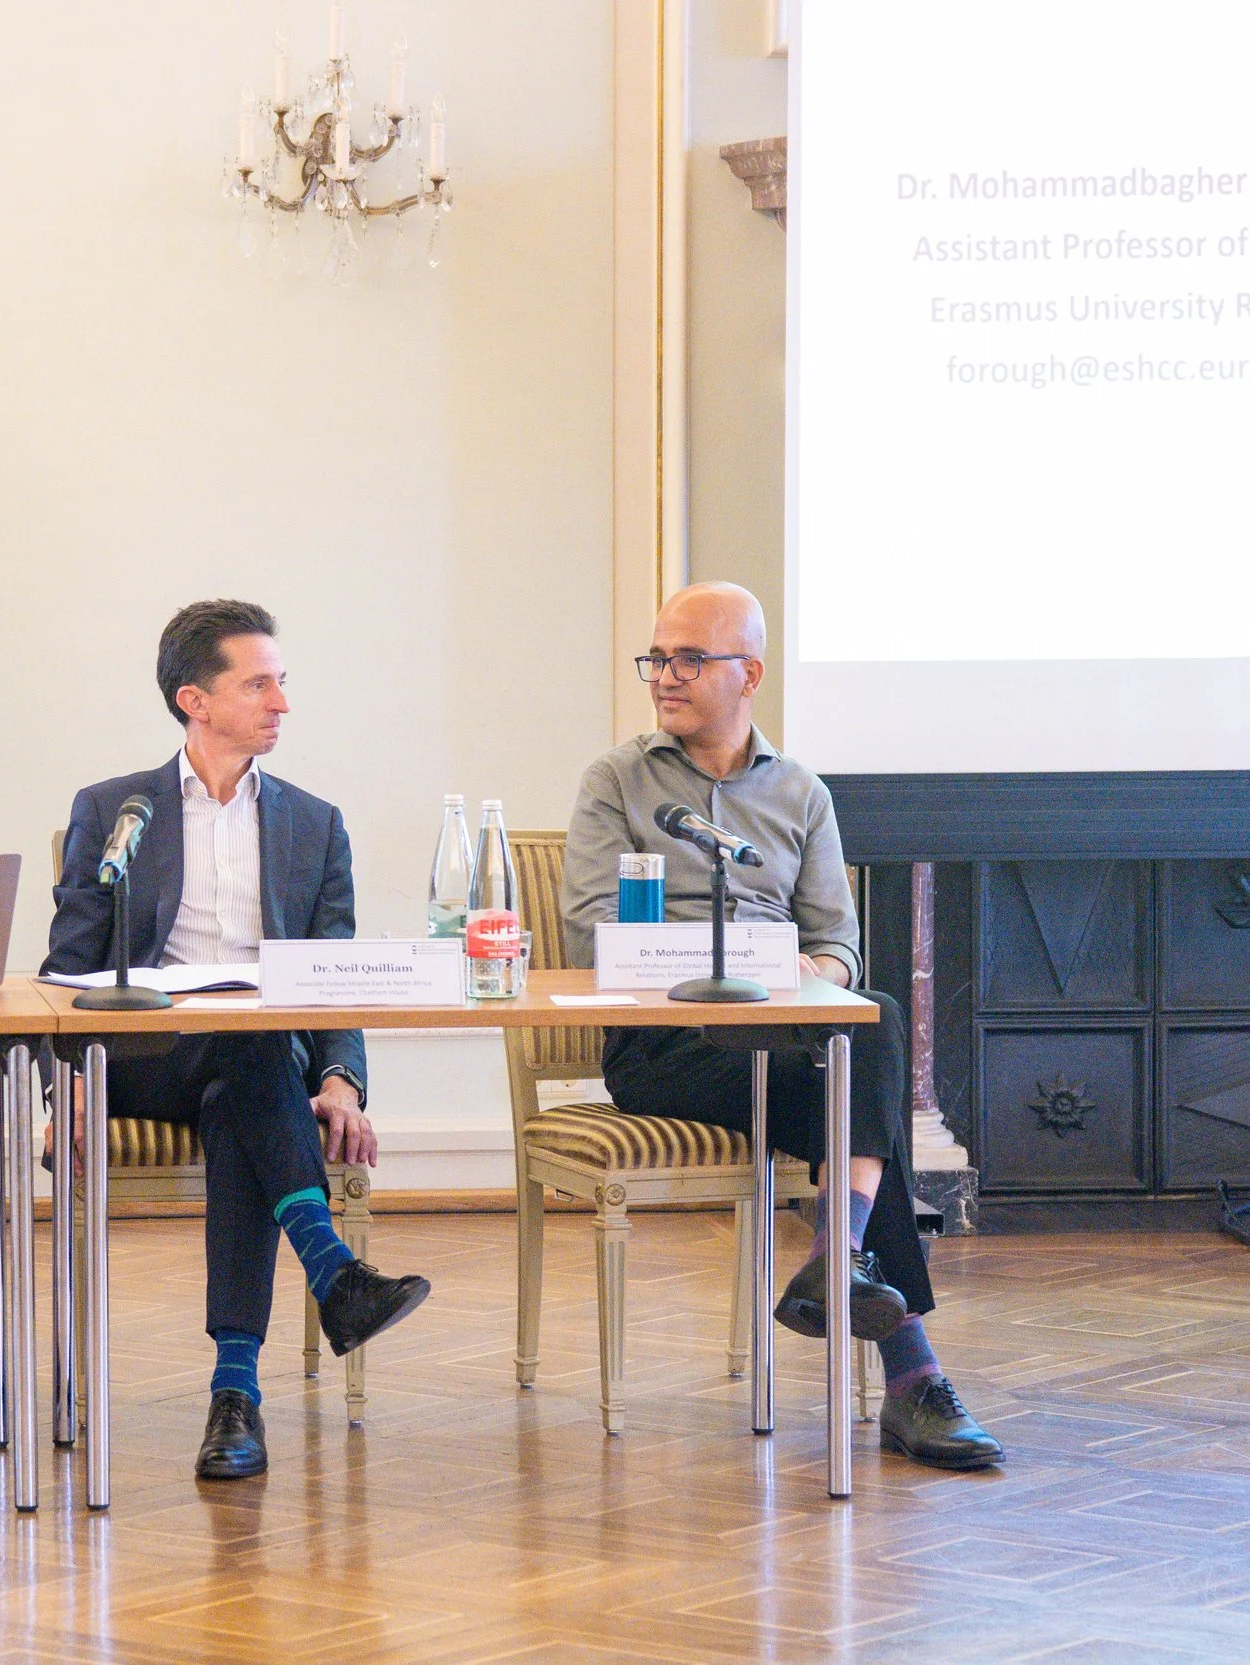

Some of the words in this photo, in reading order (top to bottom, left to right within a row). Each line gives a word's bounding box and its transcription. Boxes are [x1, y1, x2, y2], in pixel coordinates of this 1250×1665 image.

[897, 173, 937, 200] Dr.
[949, 166, 1248, 203] Mohammadbagher
[912, 233, 1052, 262] Assistant
[1063, 229, 1207, 260] Professor
[1217, 226, 1250, 258] of
[930, 297, 1058, 323] Erasmus
[1070, 292, 1225, 326] University
[312, 964, 332, 973] Dr.
[335, 963, 359, 973] Neil
[361, 963, 413, 975] Quilliam
[639, 948, 653, 957] Dr.
